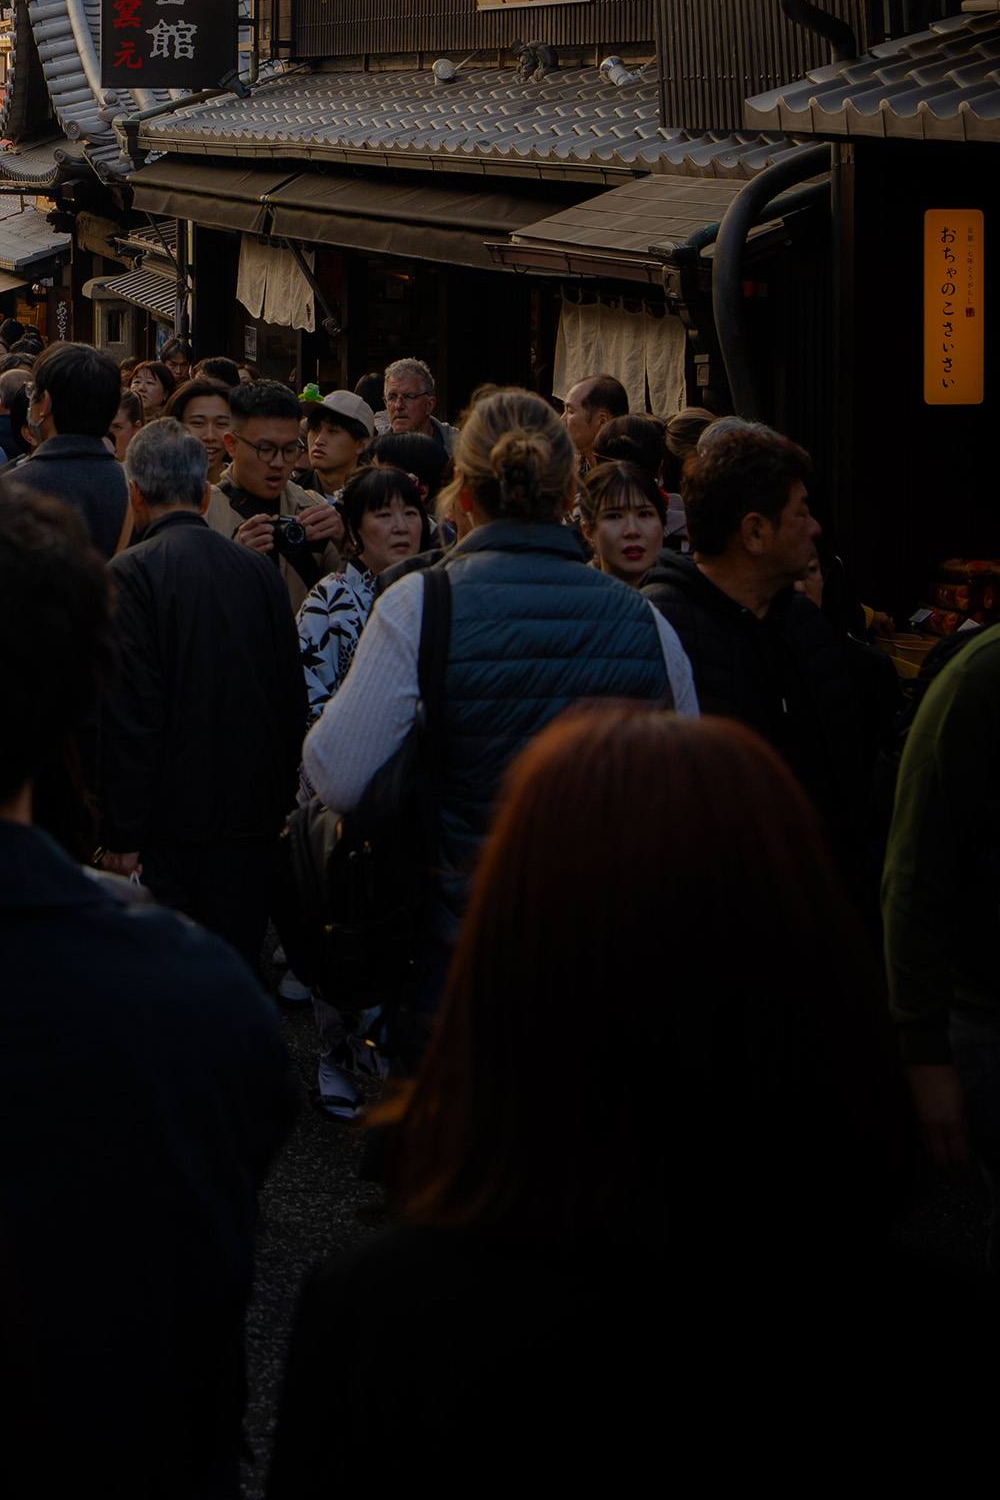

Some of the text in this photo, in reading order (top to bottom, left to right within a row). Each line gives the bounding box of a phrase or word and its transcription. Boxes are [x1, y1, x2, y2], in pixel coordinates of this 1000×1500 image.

[940, 226, 957, 388] おちゃのこさいさい
